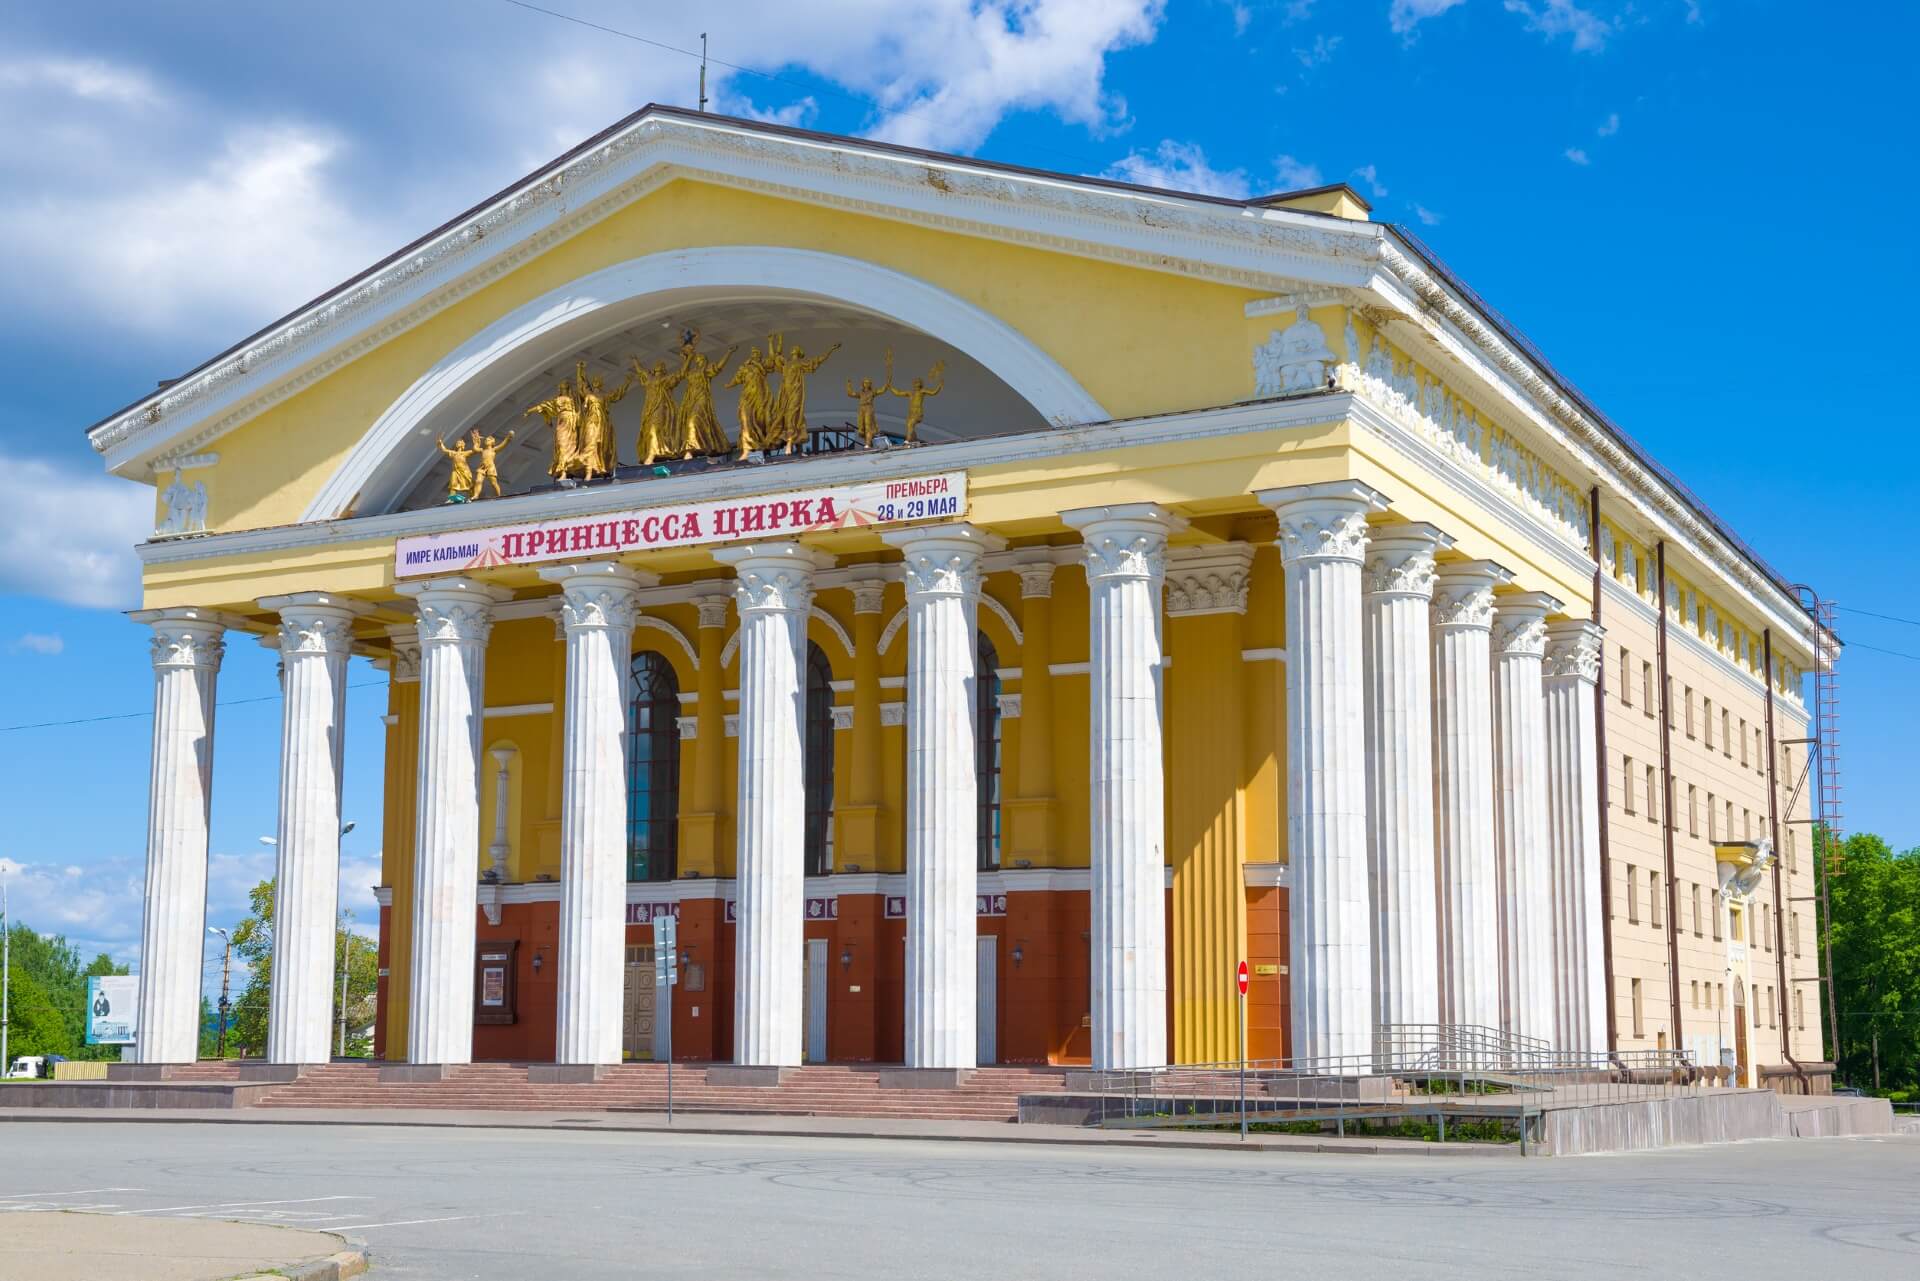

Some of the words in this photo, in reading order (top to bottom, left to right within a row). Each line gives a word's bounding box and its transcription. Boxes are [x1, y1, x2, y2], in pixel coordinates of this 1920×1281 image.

[886, 478, 949, 499] ПРЕМЬЕРА
[878, 504, 894, 521] 28
[907, 500, 924, 518] 29
[928, 496, 957, 516] МАЯ
[501, 512, 703, 559] ПРИНЦЕССА
[713, 496, 839, 537] ЦИРКА
[406, 549, 432, 565] ИМРЕ
[433, 543, 479, 562] КАЛЬМАН
